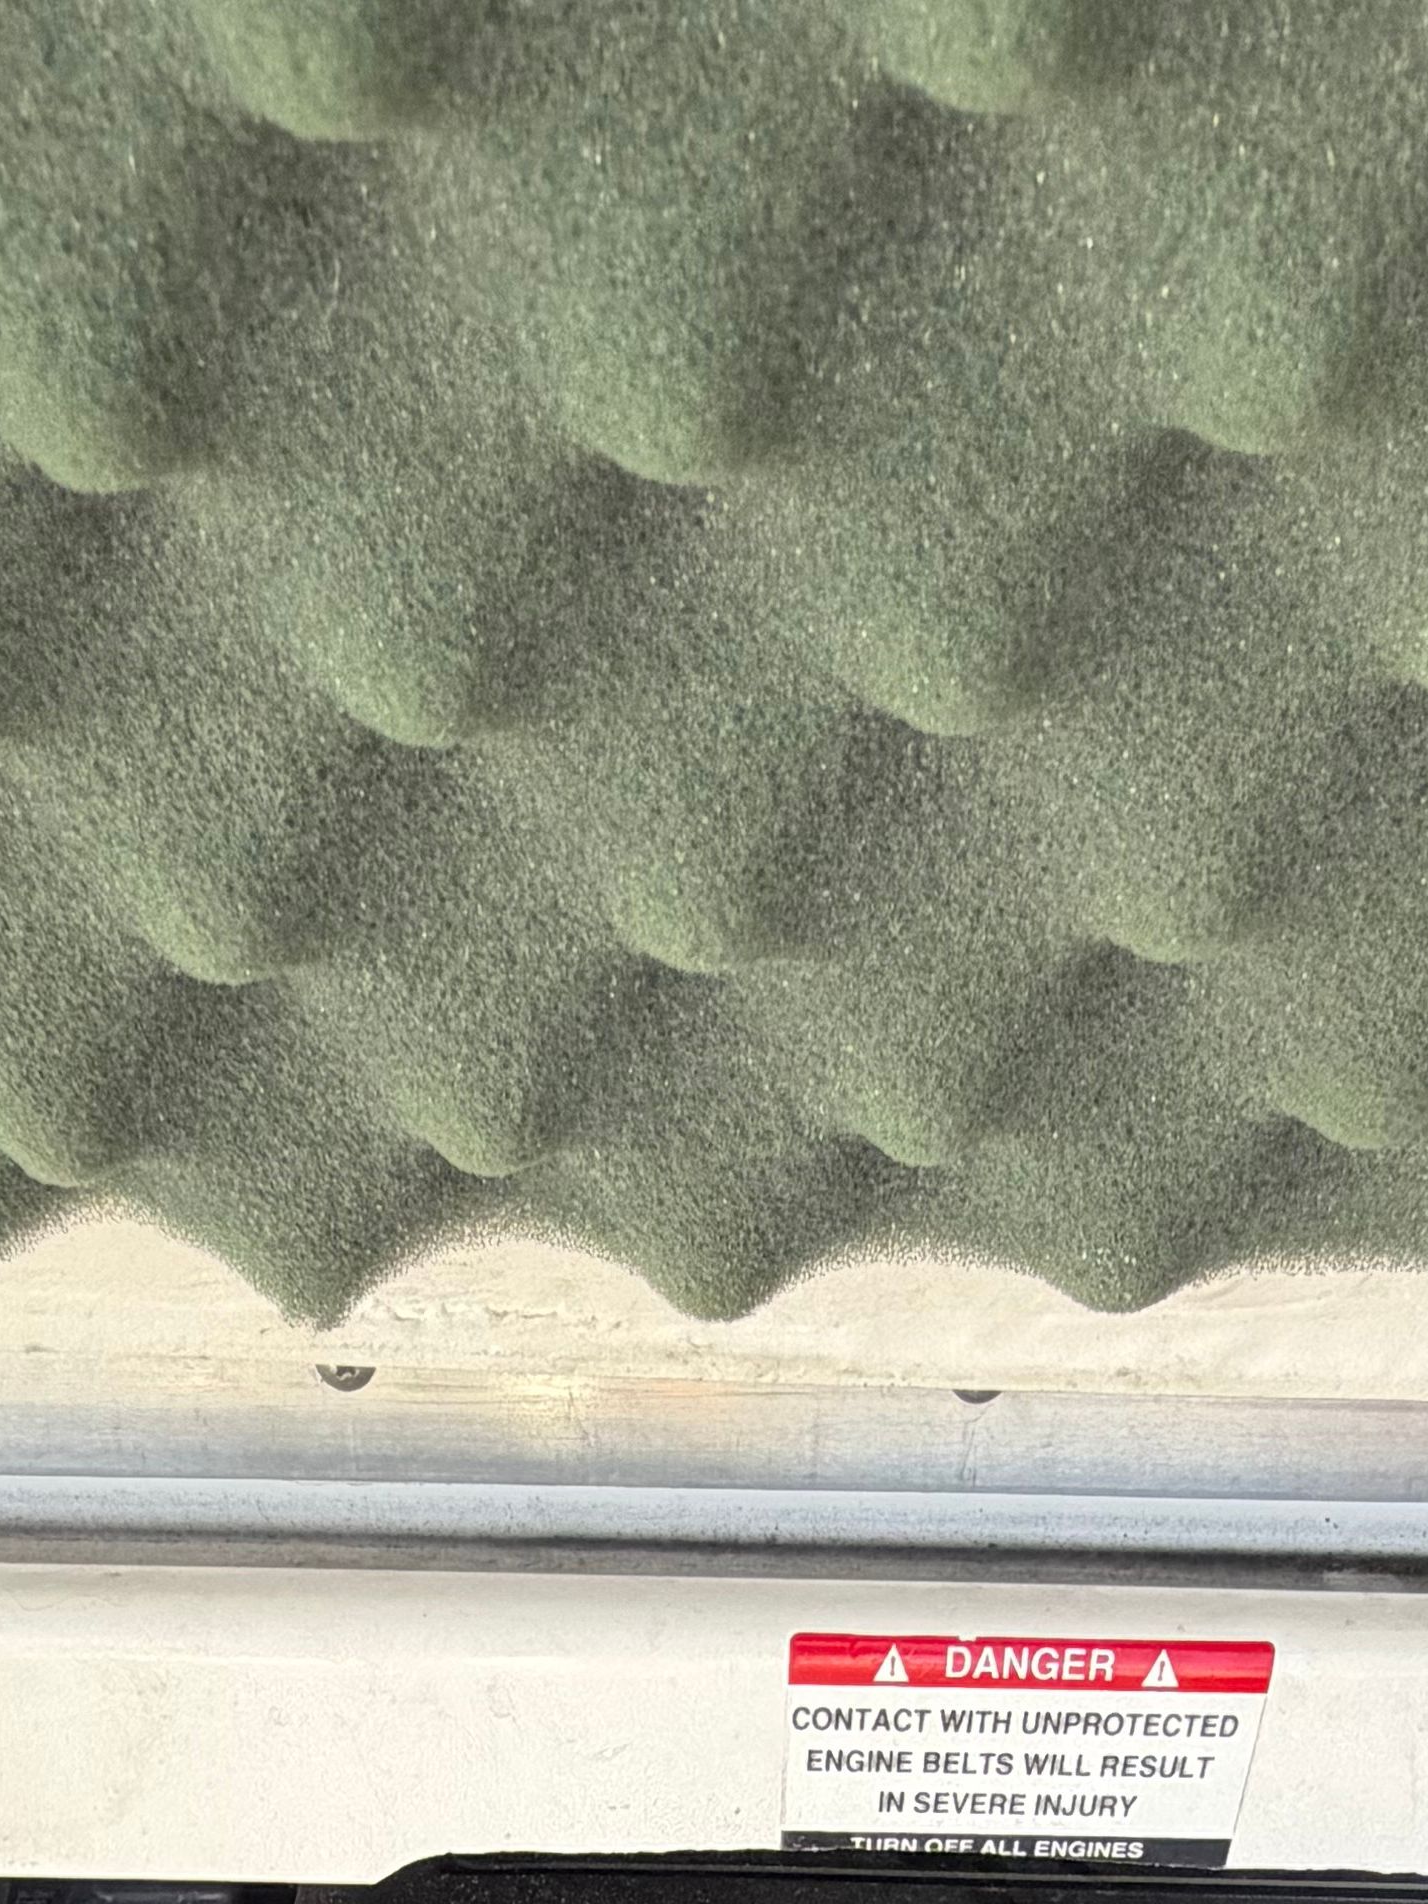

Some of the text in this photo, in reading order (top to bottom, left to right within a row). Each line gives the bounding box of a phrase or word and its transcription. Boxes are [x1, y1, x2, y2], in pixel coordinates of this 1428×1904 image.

[945, 1646, 1115, 1682] DANGER
[792, 1707, 1239, 1738] CONTACT WITH UNPROTECTED
[806, 1750, 1215, 1779] ENGINE BELTS WILL RESULT
[878, 1791, 1137, 1817] IN SEVERE INJURY
[851, 1836, 1144, 1858] TURN OFF ALL ENGINES
